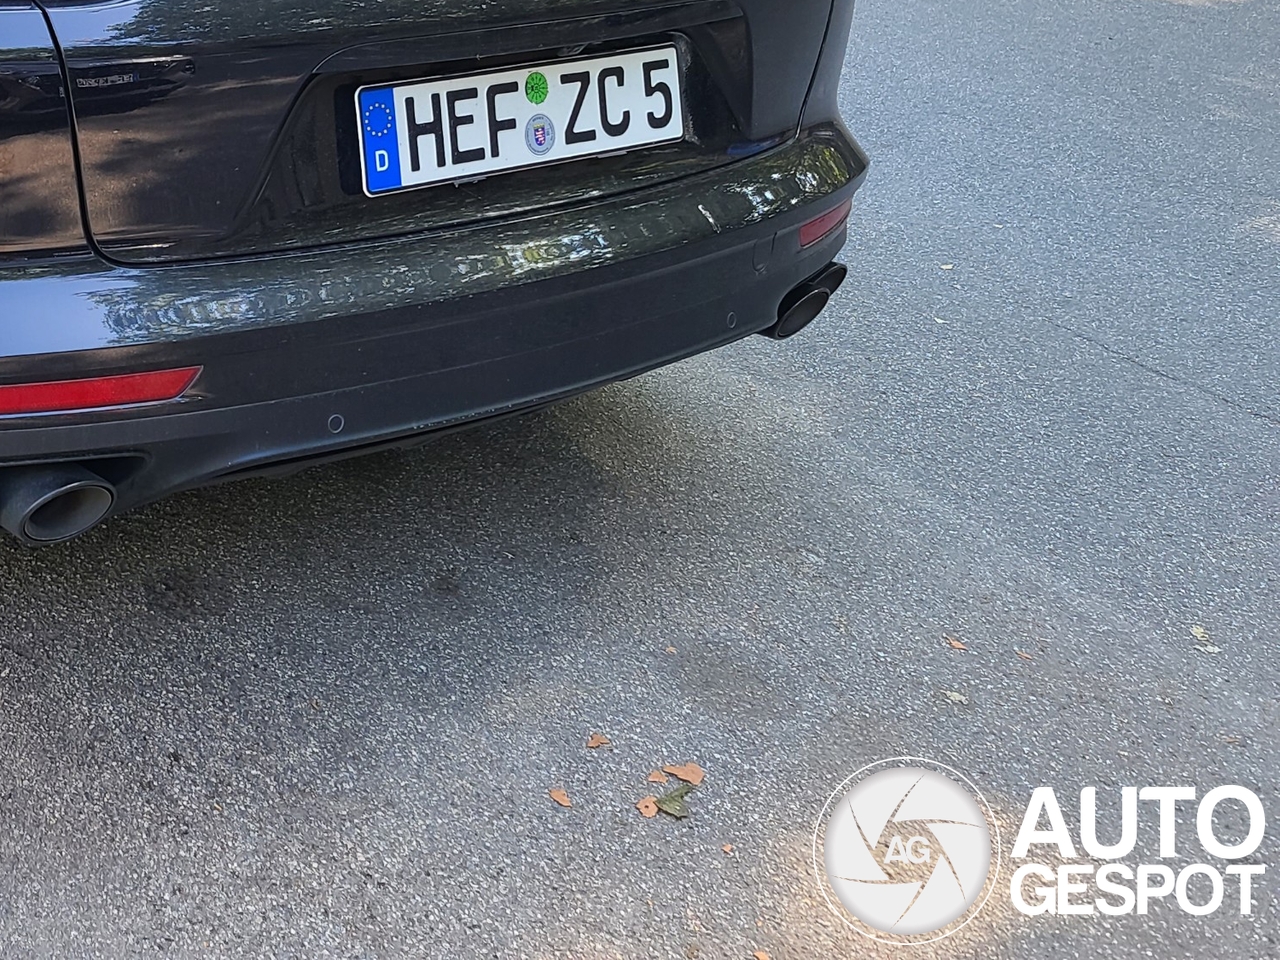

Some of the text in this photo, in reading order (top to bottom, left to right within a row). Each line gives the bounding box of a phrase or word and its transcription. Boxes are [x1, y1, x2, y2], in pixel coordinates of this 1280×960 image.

[404, 81, 519, 172] HEF
[560, 66, 630, 145] ZC
[641, 58, 672, 129] 5
[375, 149, 389, 172] D
